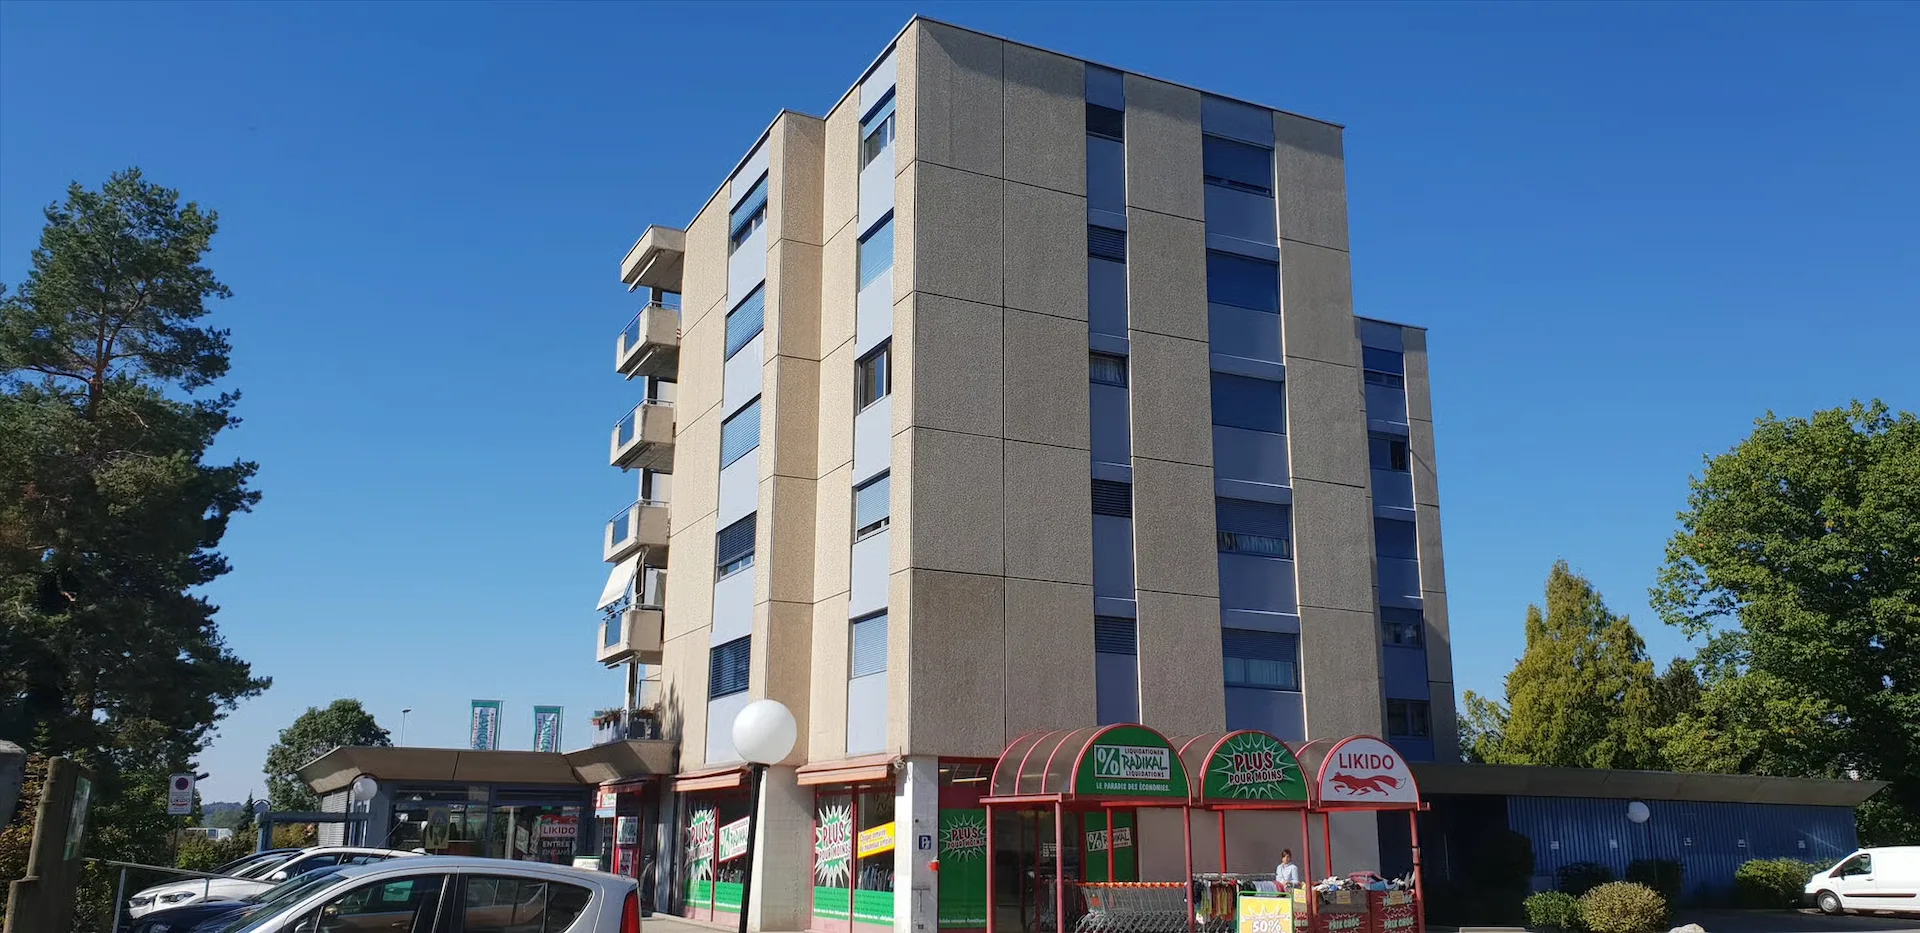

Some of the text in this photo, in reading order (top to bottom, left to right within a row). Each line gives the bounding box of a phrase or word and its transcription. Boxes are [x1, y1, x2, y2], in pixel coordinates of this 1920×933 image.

[1121, 753, 1168, 771] RADIKAL
[1234, 751, 1274, 771] PLUS
[1339, 753, 1395, 770] LIKIDO
[1126, 770, 1164, 778] LIQUIDATIONS
[1229, 770, 1283, 784] POUR MOINS
[1104, 782, 1127, 790] PARADIS
[543, 826, 576, 835] LIKIDO
[691, 821, 709, 844] PLUS
[823, 821, 844, 844] PLUS
[952, 827, 979, 840] PLUS
[1252, 919, 1281, 932] 50%
[1329, 919, 1343, 930] PRIX
[1384, 919, 1398, 930] PRIX
